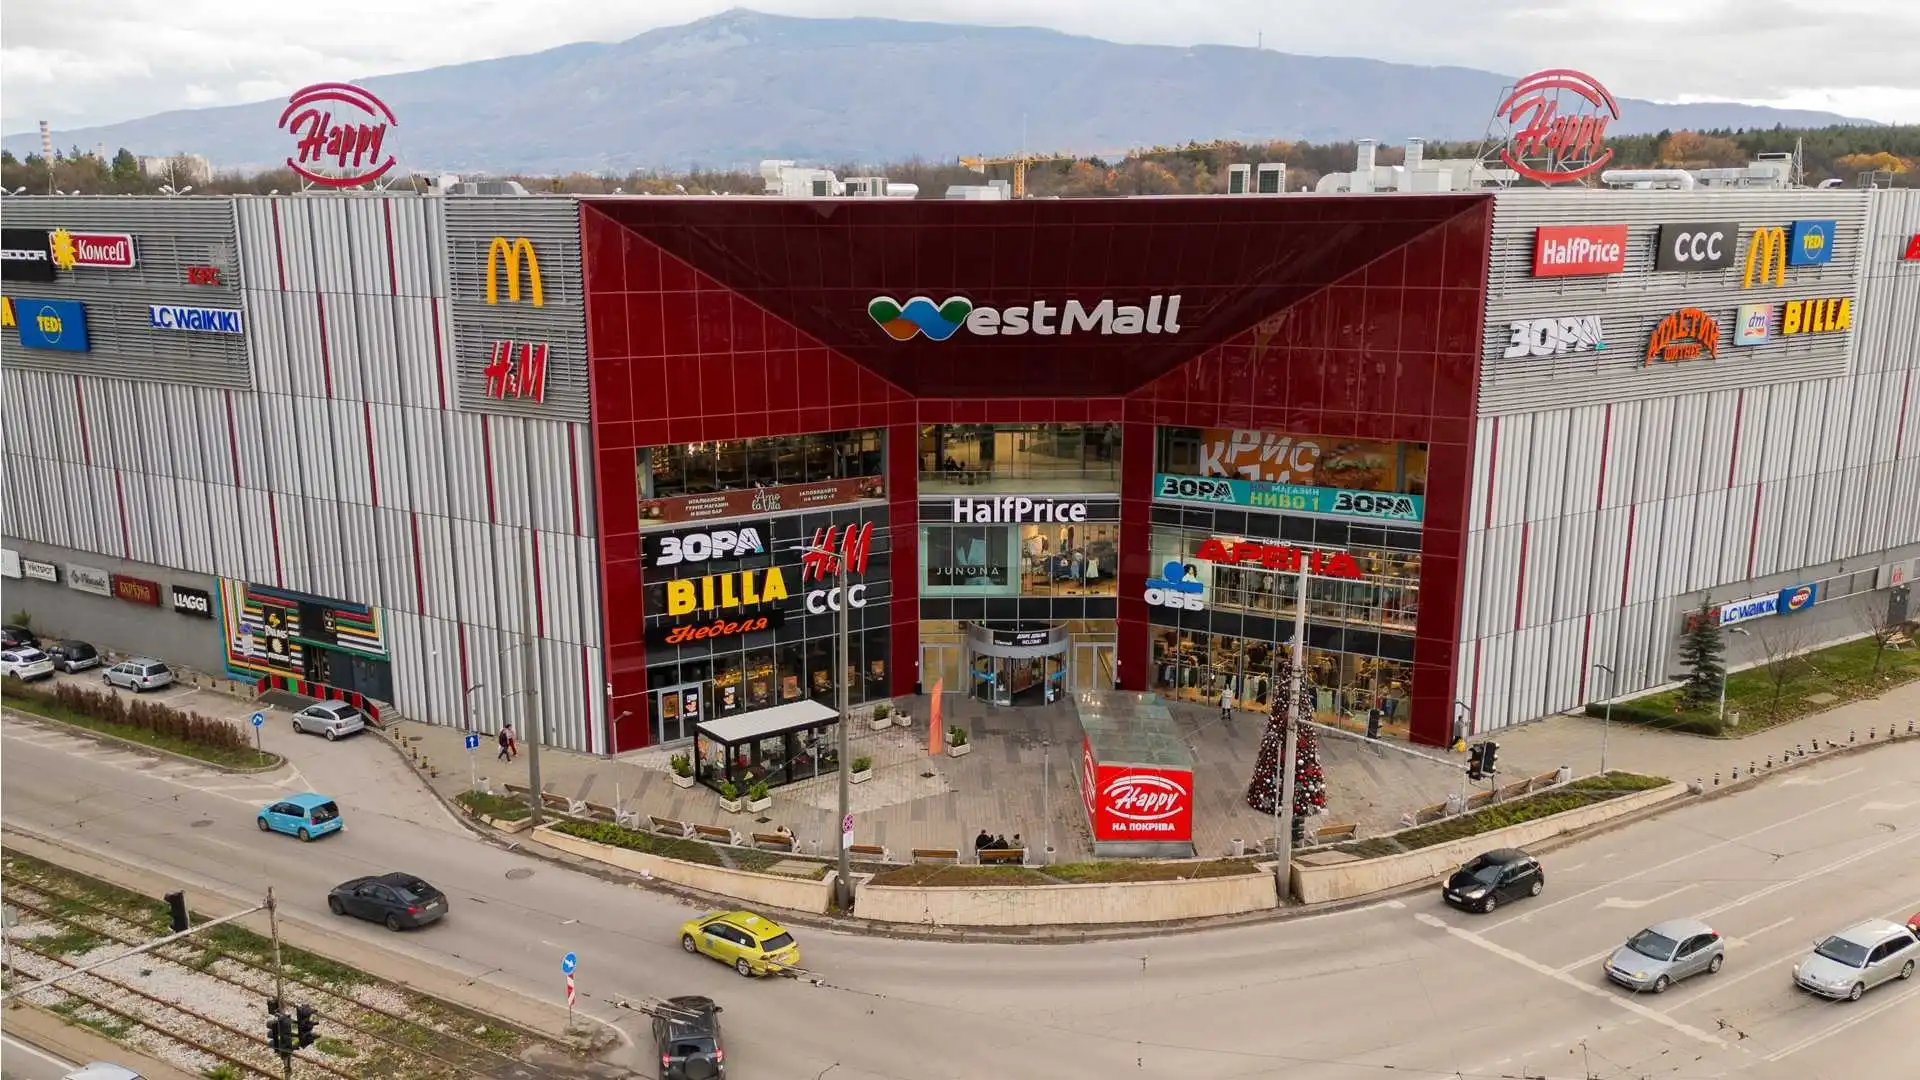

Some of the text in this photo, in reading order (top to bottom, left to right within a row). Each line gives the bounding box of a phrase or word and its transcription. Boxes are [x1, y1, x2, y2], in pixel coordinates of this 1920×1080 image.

[290, 108, 387, 167] Happy
[1509, 95, 1609, 161] Happy
[1542, 237, 1620, 265] HalfPrice
[1674, 231, 1724, 262] CCC
[150, 306, 171, 328] LC
[1748, 311, 1766, 328] dm
[1781, 297, 1851, 334] BILLA
[1503, 315, 1603, 359] ЗОРА
[483, 340, 549, 407] H&M
[1162, 477, 1234, 501] ЗОРА
[1250, 492, 1320, 512] НИВО 1
[953, 496, 1088, 523] HalfPrice
[1333, 493, 1415, 517] ЗОРА
[656, 527, 765, 566] ЗОРА
[801, 520, 873, 583] H&M
[1262, 537, 1292, 547] КИНО
[936, 567, 1001, 576] JUNONA
[666, 566, 788, 616] BILLA
[806, 583, 867, 615] CCC
[1143, 588, 1204, 611] ОББ
[664, 617, 769, 645] Неделя
[1110, 785, 1180, 812] Happy
[1112, 823, 1175, 831] НА ПОКРИВА
